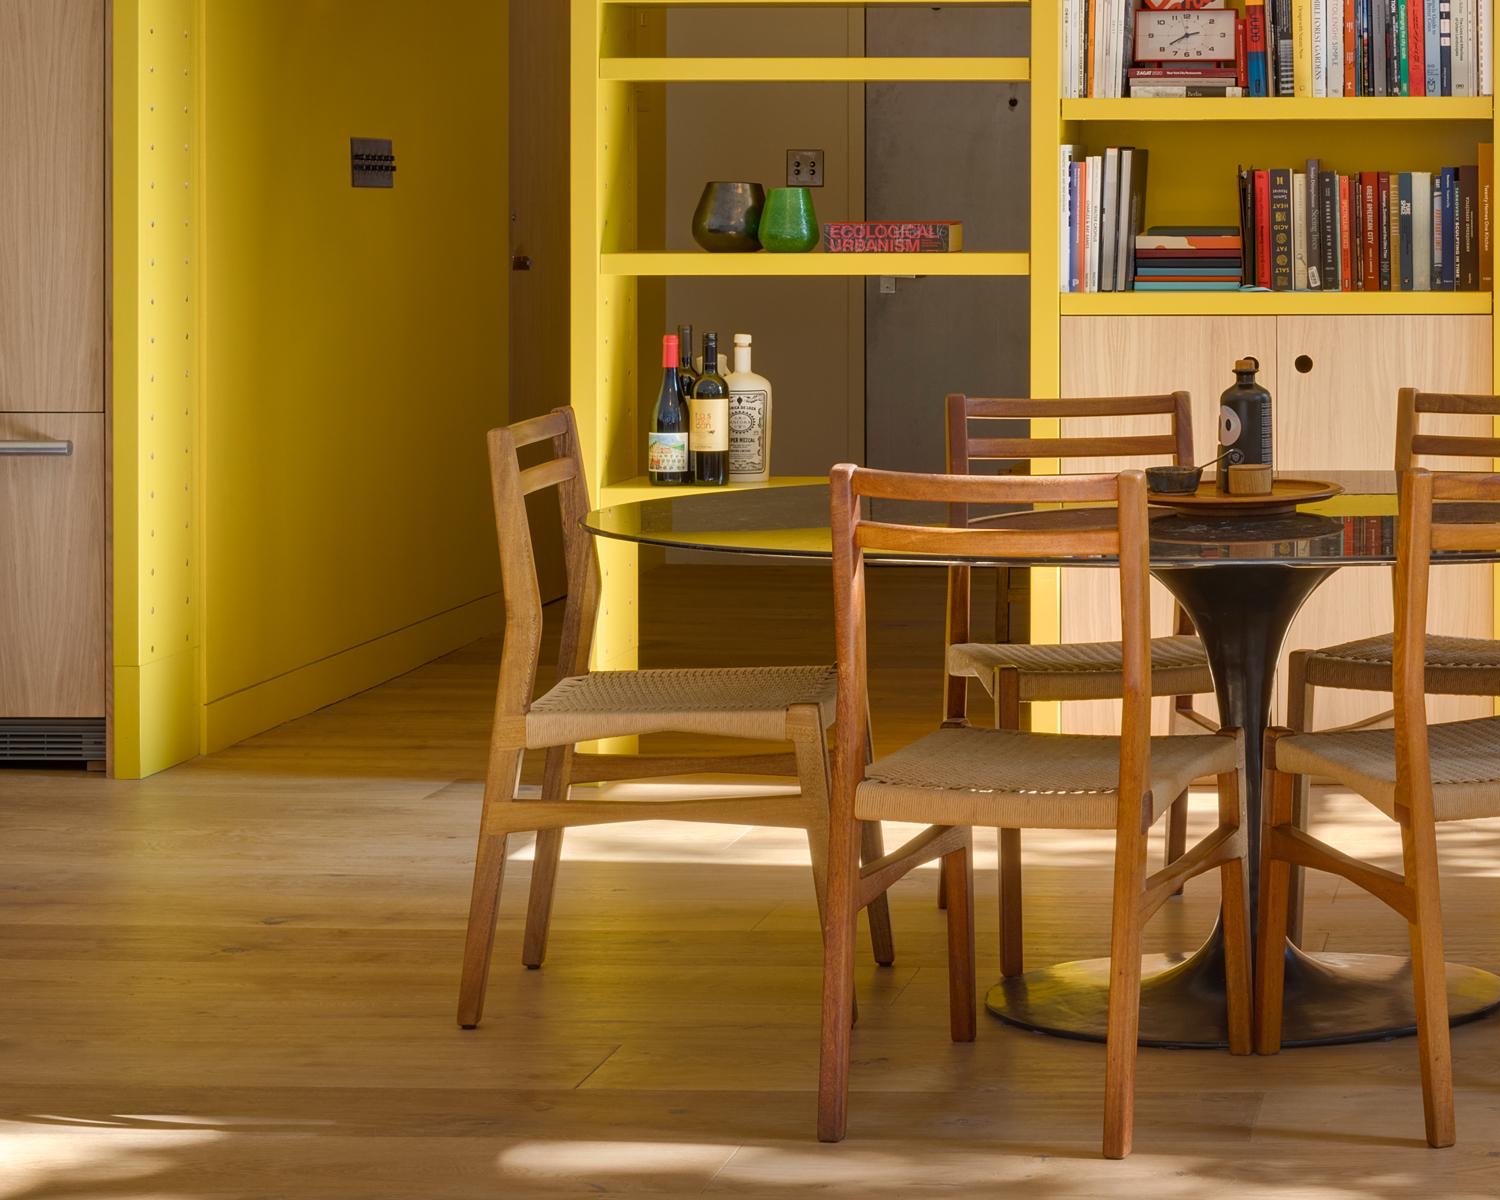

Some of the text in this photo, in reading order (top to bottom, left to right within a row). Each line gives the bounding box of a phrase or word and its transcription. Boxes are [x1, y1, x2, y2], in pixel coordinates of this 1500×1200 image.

[1251, 15, 1259, 42] JUDD
[1313, 19, 1321, 42] FOREST
[1314, 45, 1322, 80] GARDENS
[830, 225, 939, 238] ECOLOGICAL
[830, 240, 919, 252] URBANISM
